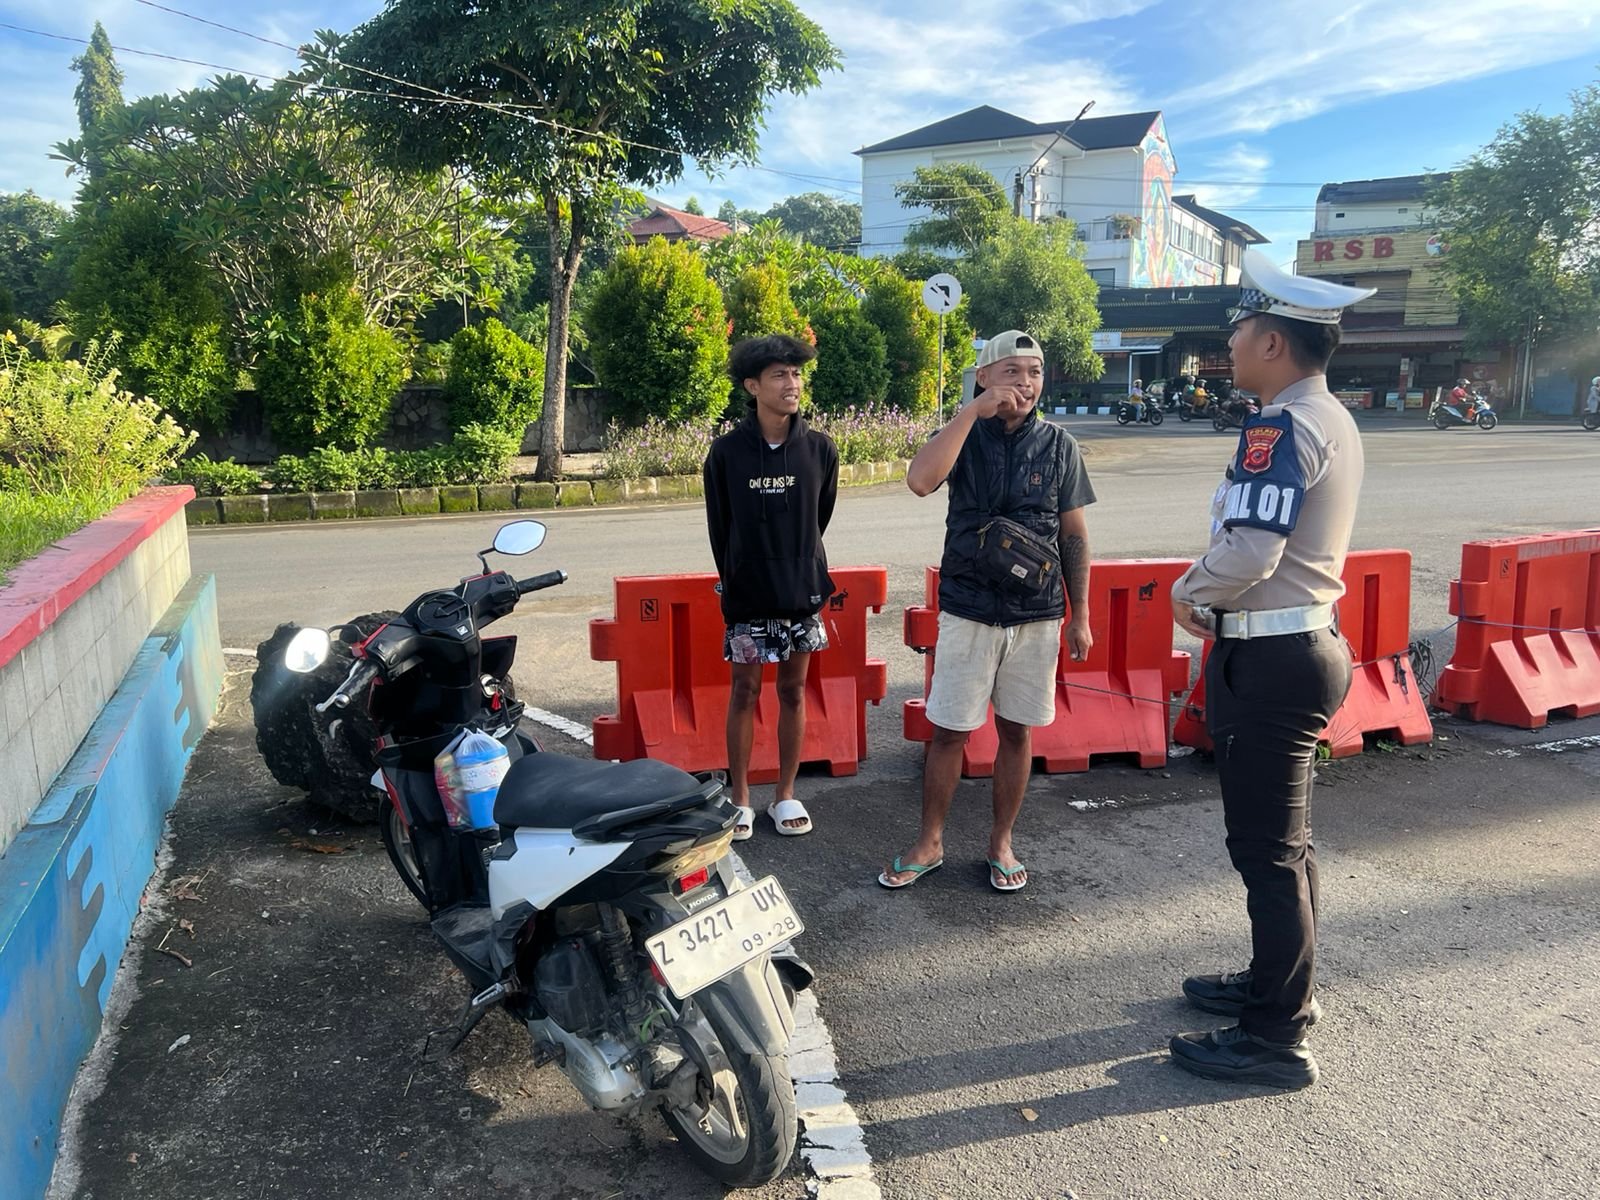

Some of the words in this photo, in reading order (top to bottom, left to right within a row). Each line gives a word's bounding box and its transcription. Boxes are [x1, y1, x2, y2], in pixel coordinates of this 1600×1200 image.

[1313, 236, 1394, 262] RSB
[1257, 484, 1295, 525] 01
[688, 892, 719, 909] HONDA
[653, 940, 674, 966] Z
[679, 908, 734, 952] 3427
[751, 882, 784, 912] UK
